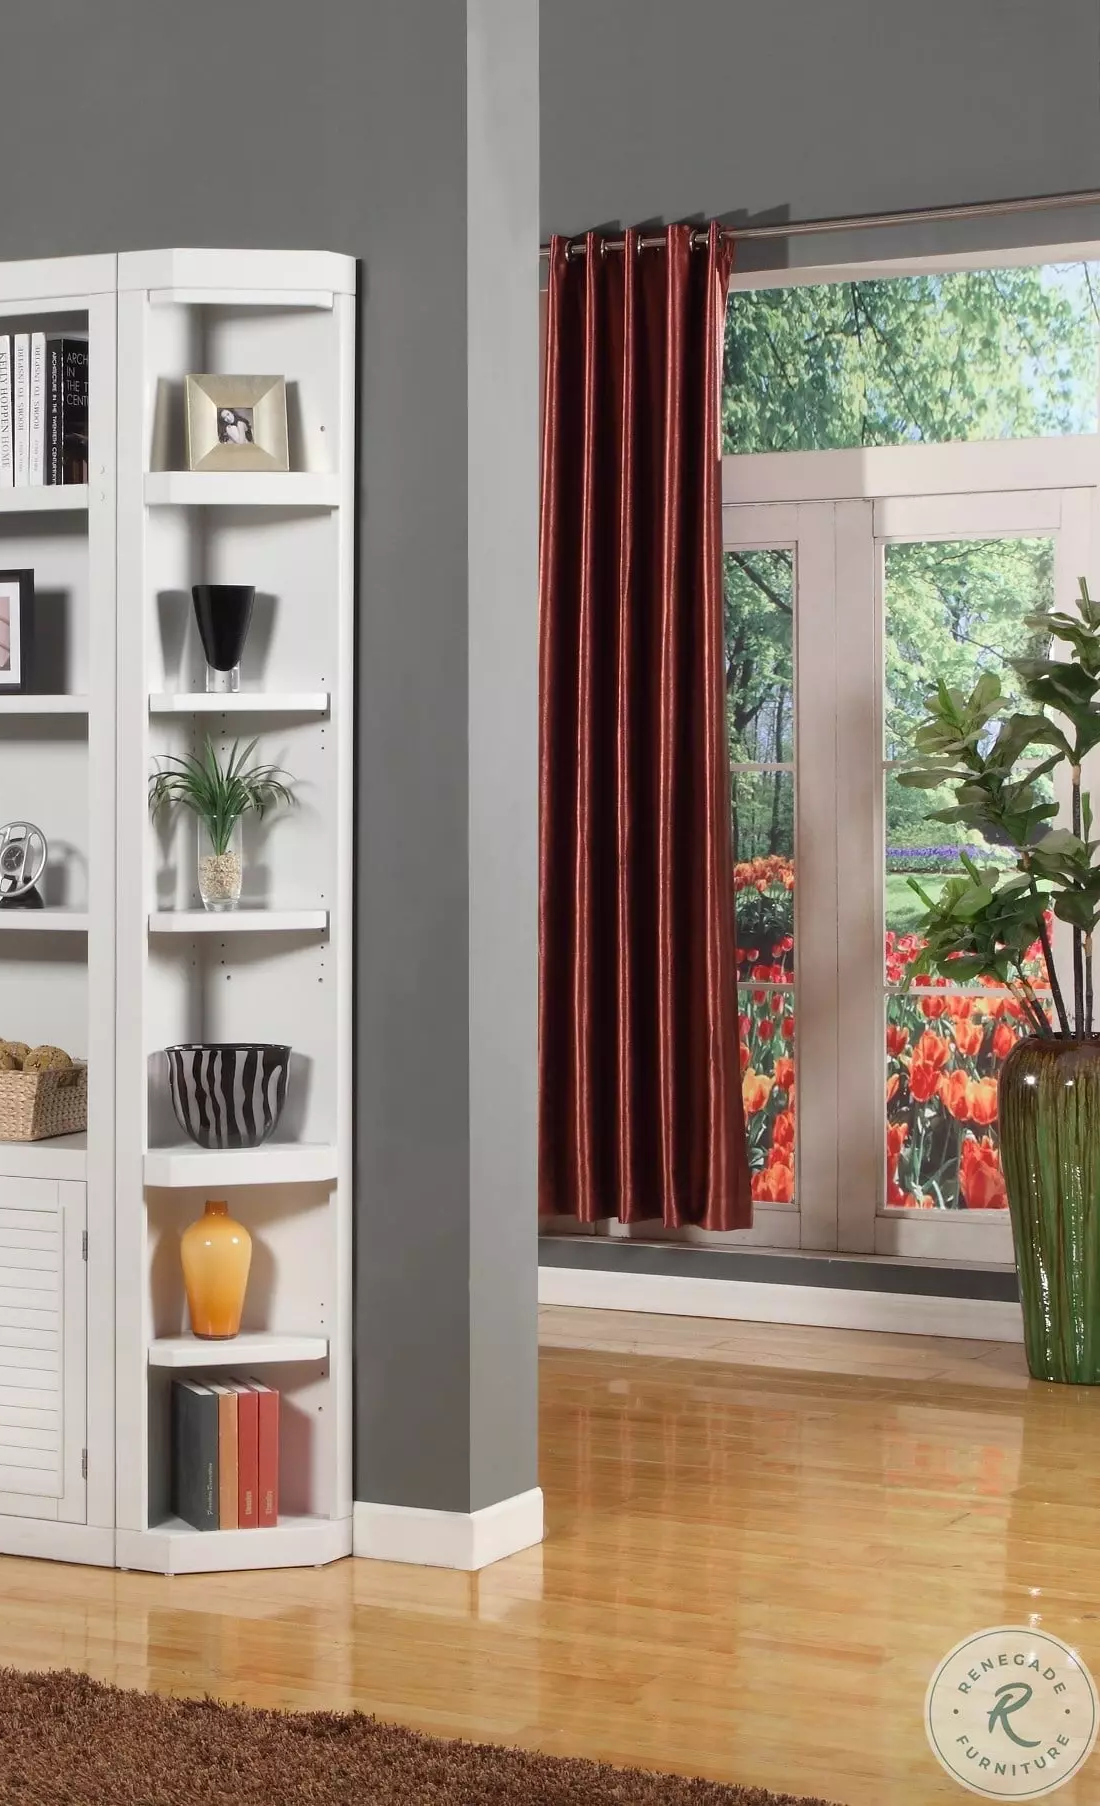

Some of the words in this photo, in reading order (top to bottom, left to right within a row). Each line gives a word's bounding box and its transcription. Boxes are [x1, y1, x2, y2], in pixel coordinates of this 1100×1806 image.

[0, 352, 9, 385] KELLY
[66, 366, 76, 378] IN
[66, 379, 80, 393] THE
[0, 388, 9, 433] HOPPEN
[66, 393, 89, 406] CENT
[1, 435, 10, 469] HOME
